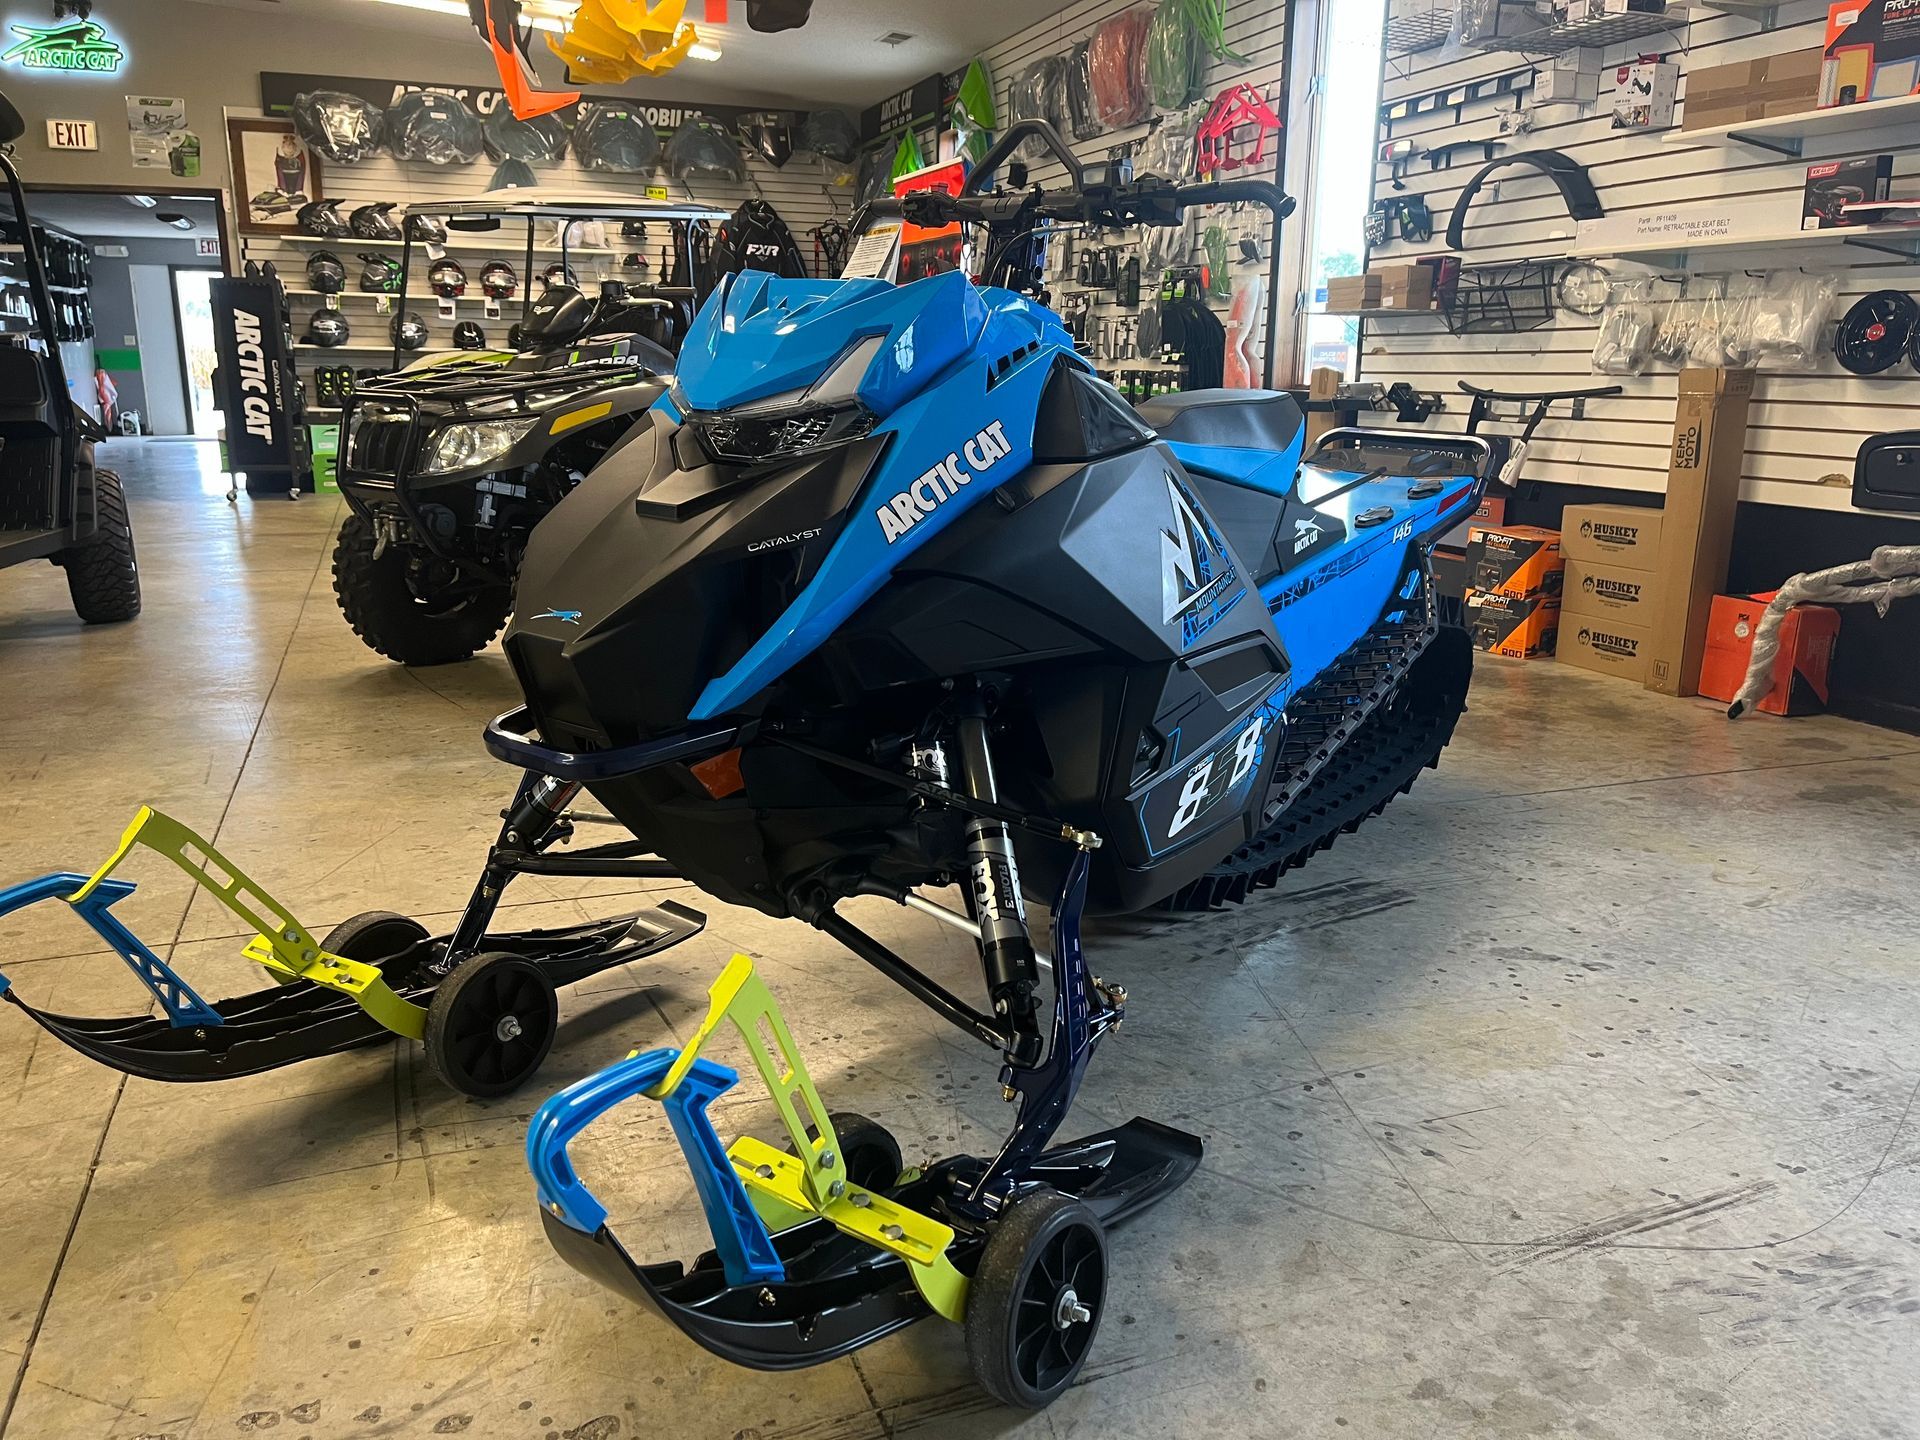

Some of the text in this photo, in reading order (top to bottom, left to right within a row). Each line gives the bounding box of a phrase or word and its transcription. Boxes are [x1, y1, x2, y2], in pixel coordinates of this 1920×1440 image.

[24, 48, 118, 70] ARCTIC CAT
[55, 122, 87, 147] EXIT
[1637, 226, 1647, 234] Part
[1663, 220, 1701, 231] RETRACTABLE
[1702, 219, 1716, 228] SEAT
[1717, 218, 1731, 227] BELT
[1687, 230, 1702, 238] MADE
[1711, 228, 1728, 236] CHINA
[200, 239, 219, 255] EXIT
[745, 243, 780, 257] FXR
[233, 307, 273, 443] ARCTIC CAT
[271, 359, 284, 412] CATALYST
[1674, 433, 1687, 469] KEMI
[1683, 426, 1697, 469] MOTO
[876, 419, 1012, 544] ARCTIC CAT
[748, 527, 822, 552] CATALYST
[1294, 529, 1318, 555] ARCTIC CAT
[1392, 519, 1412, 544] 146
[1487, 534, 1514, 545] PRO-FIT
[1593, 523, 1639, 538] HUSKEY
[1195, 566, 1237, 613] MOUNTAINCAT
[1483, 593, 1510, 605] PRO-FIT
[1596, 579, 1641, 595] HUSKEY
[1592, 631, 1639, 650] HUSKEY
[912, 743, 946, 774] FOX
[1168, 716, 1263, 838] 858
[972, 857, 1000, 926] FOX
[999, 864, 1015, 909] FLOAT 3
